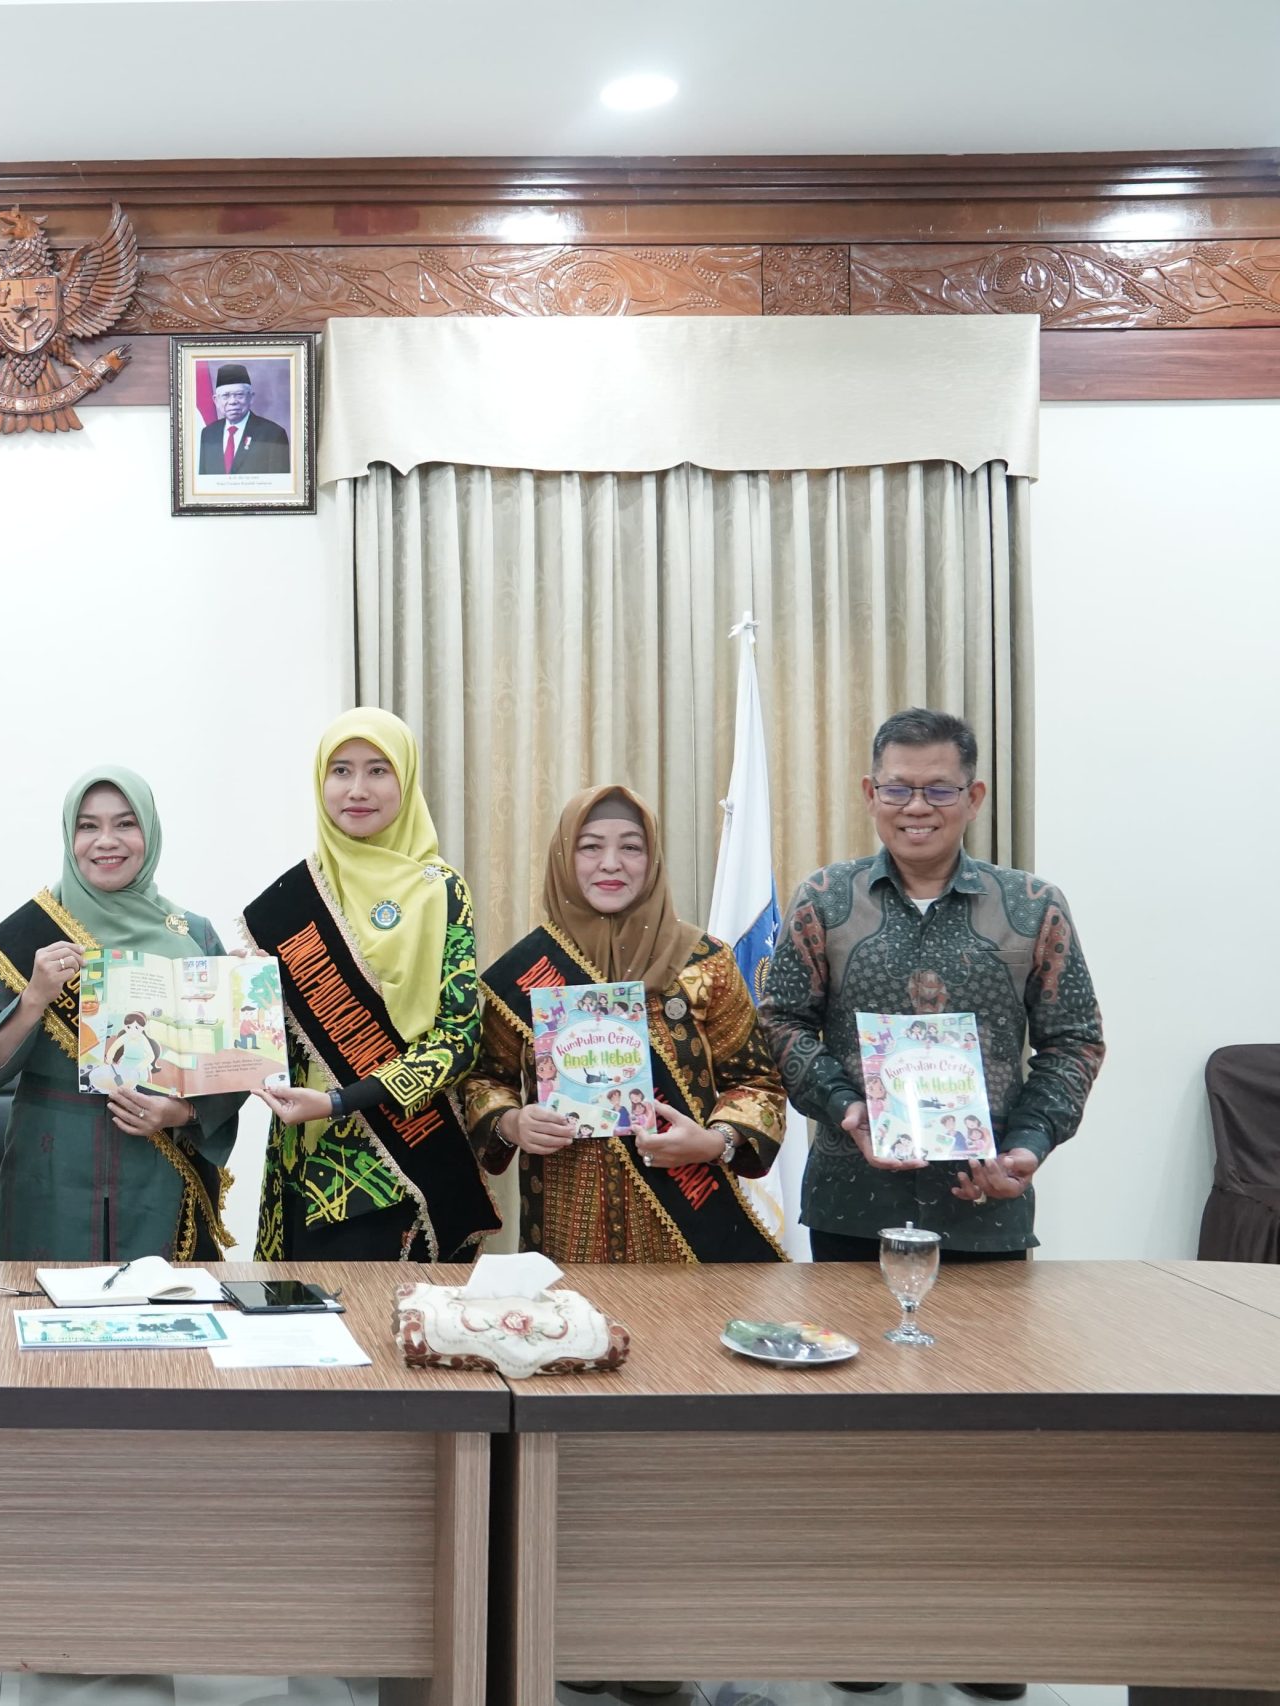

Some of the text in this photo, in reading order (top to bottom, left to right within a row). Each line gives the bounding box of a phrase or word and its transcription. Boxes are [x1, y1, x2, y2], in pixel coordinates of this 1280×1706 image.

[277, 920, 330, 992] BUNDA
[303, 962, 352, 1022] PAUD
[607, 1031, 641, 1048] Cerita
[563, 1048, 642, 1069] Anak Hebat
[939, 1059, 975, 1076] Cerita
[932, 1075, 975, 1093] Hebat
